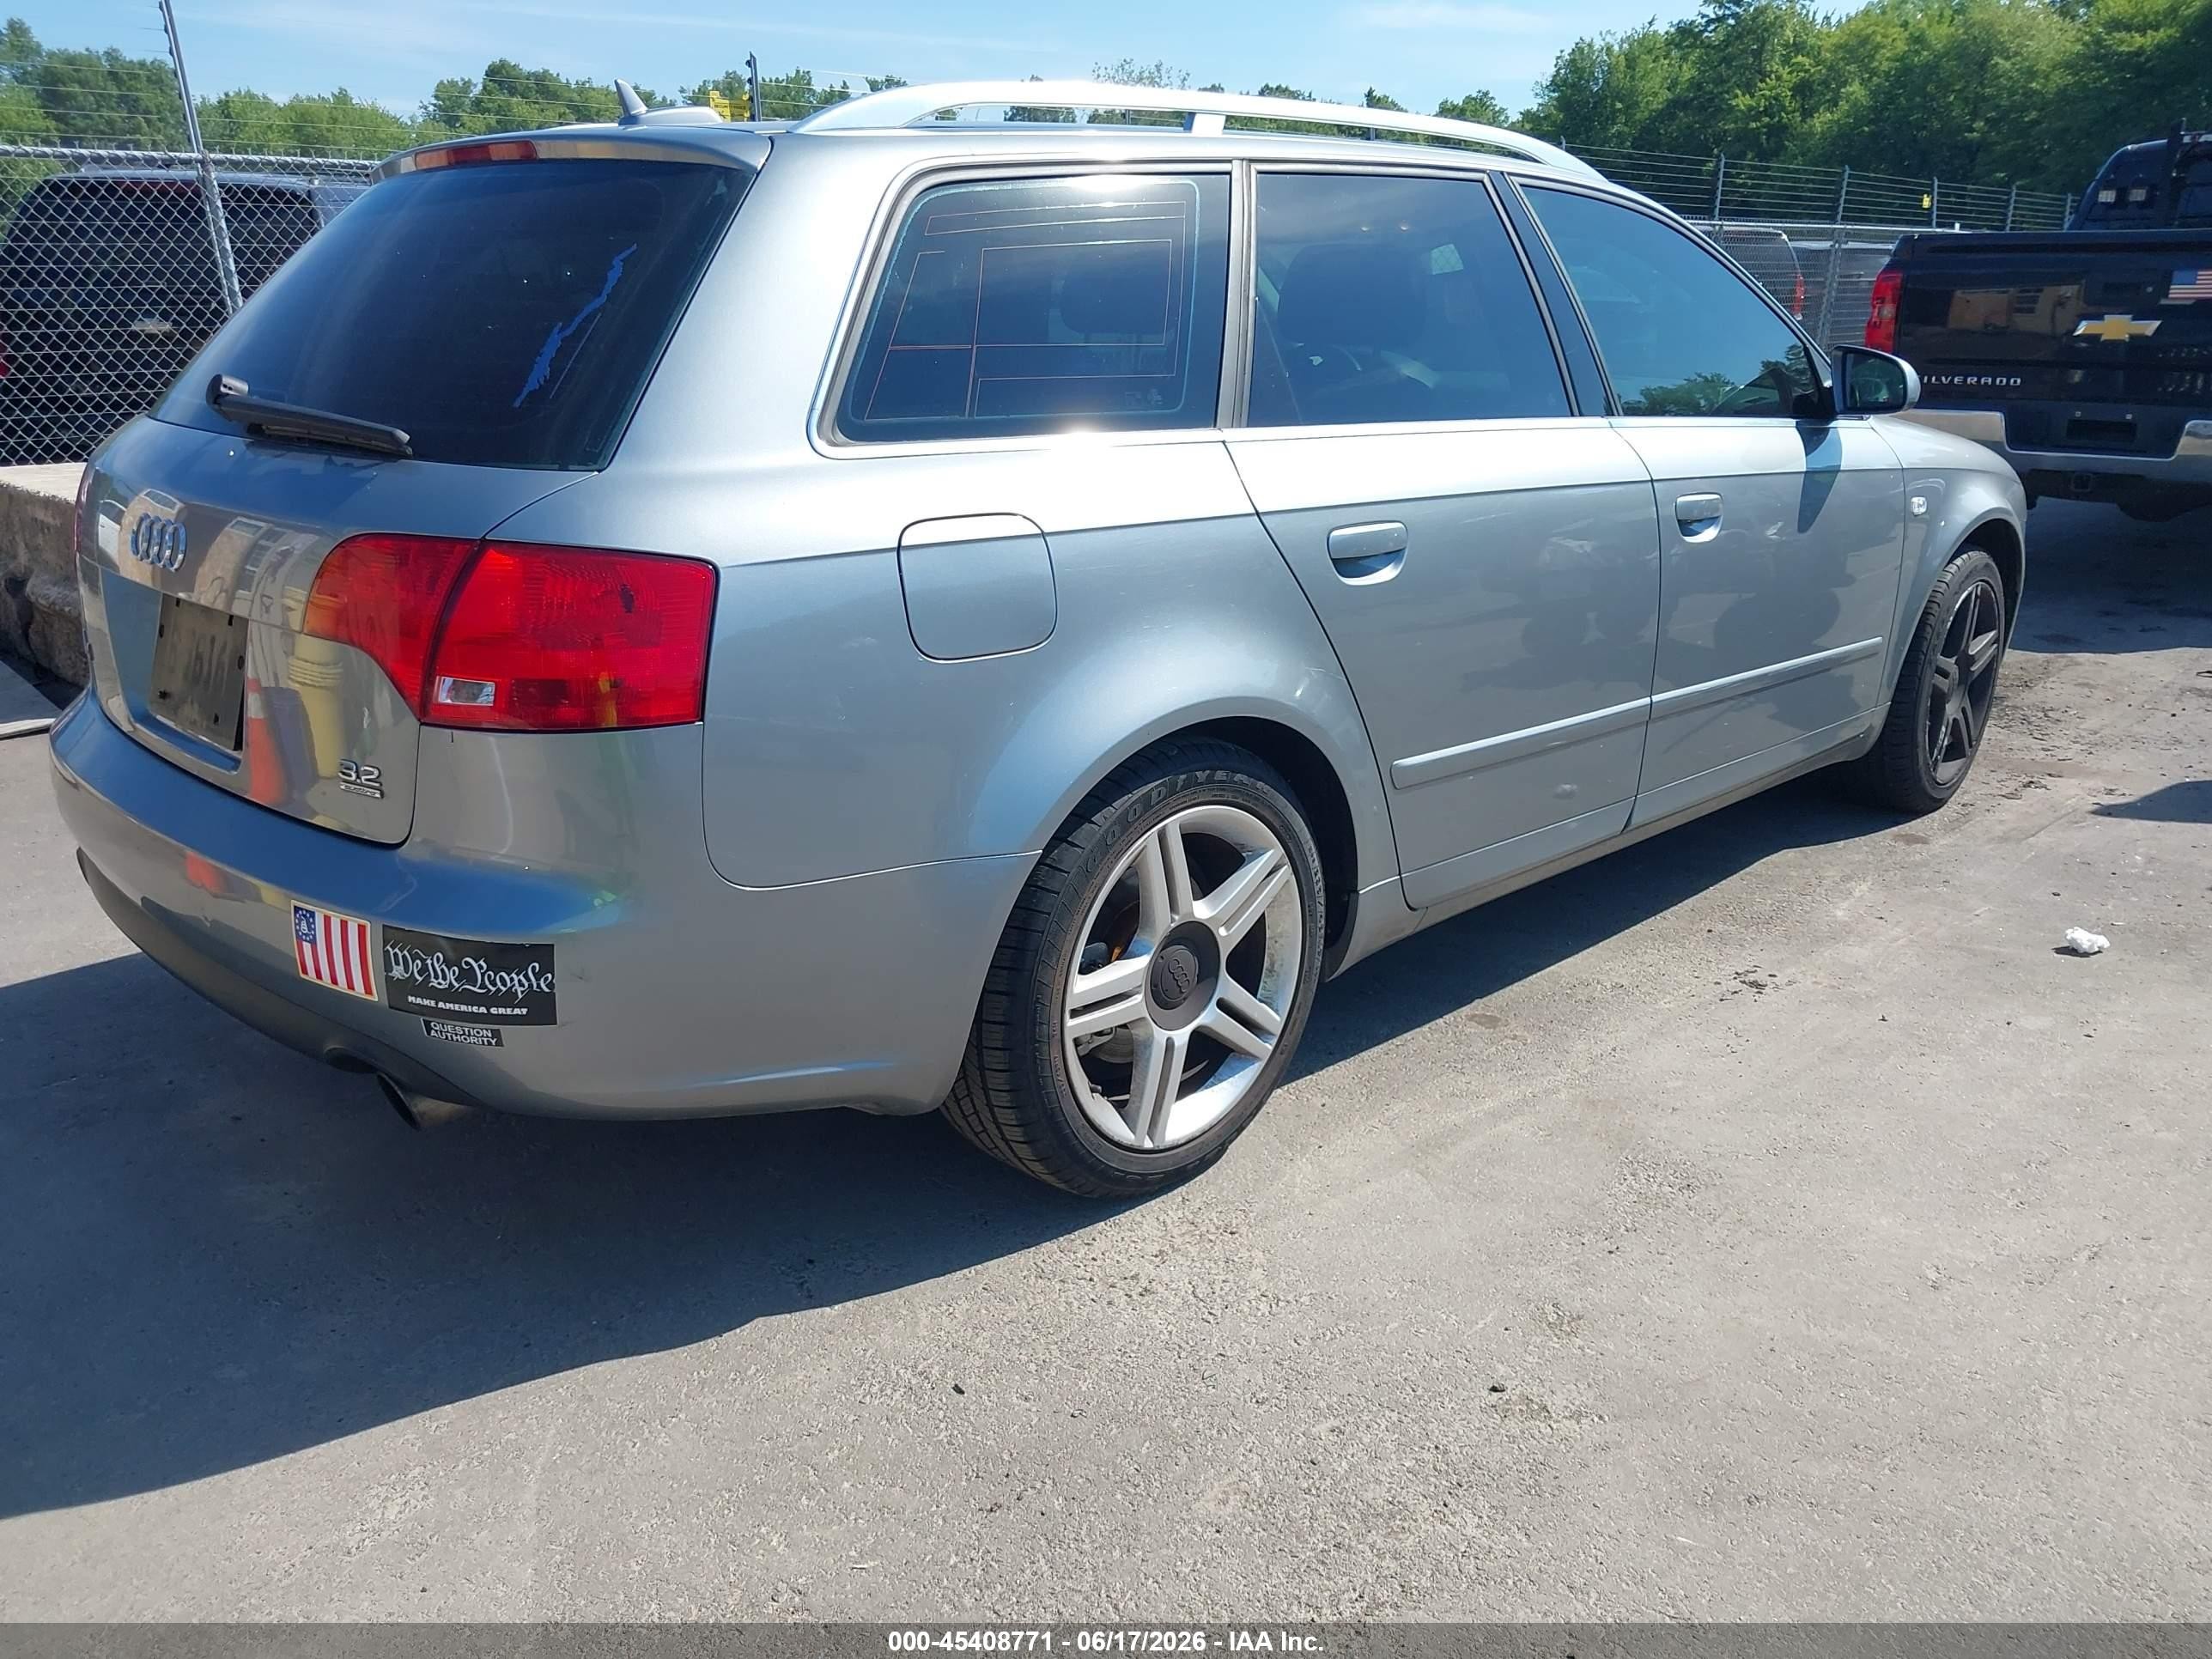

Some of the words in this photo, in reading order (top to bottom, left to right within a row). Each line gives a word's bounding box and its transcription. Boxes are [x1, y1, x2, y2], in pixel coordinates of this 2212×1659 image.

[1919, 375, 2021, 386] ILVERADO
[337, 760, 380, 787] 3.2
[385, 940, 428, 986] We
[459, 957, 555, 1005] People
[407, 995, 437, 1008] MAKE
[437, 1001, 489, 1014] AMERICA
[489, 1006, 529, 1016] GREAT
[429, 1030, 498, 1046] AUTHORITY
[430, 1022, 492, 1038] QUESTION
